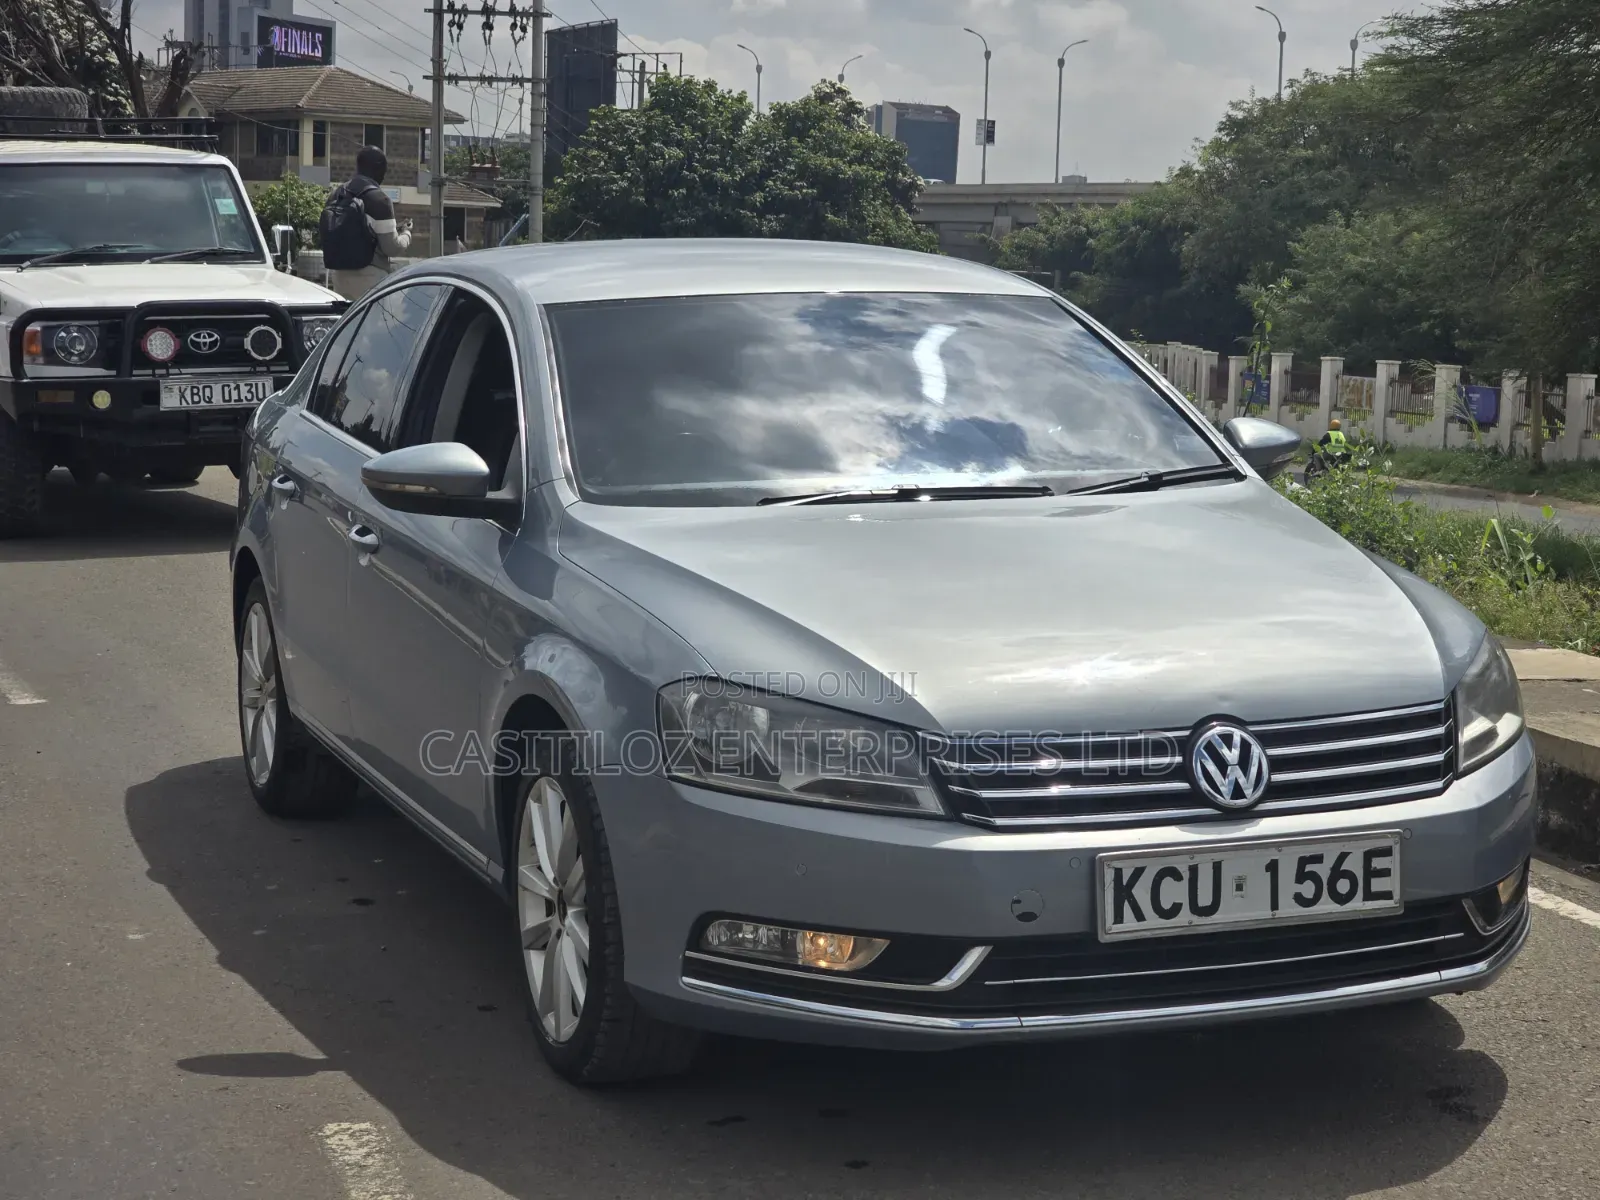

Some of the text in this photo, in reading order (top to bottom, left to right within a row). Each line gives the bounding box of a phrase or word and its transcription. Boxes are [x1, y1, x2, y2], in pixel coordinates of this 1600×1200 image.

[179, 383, 266, 405] KBQ 013U
[1112, 846, 1394, 925] KCU 156E
